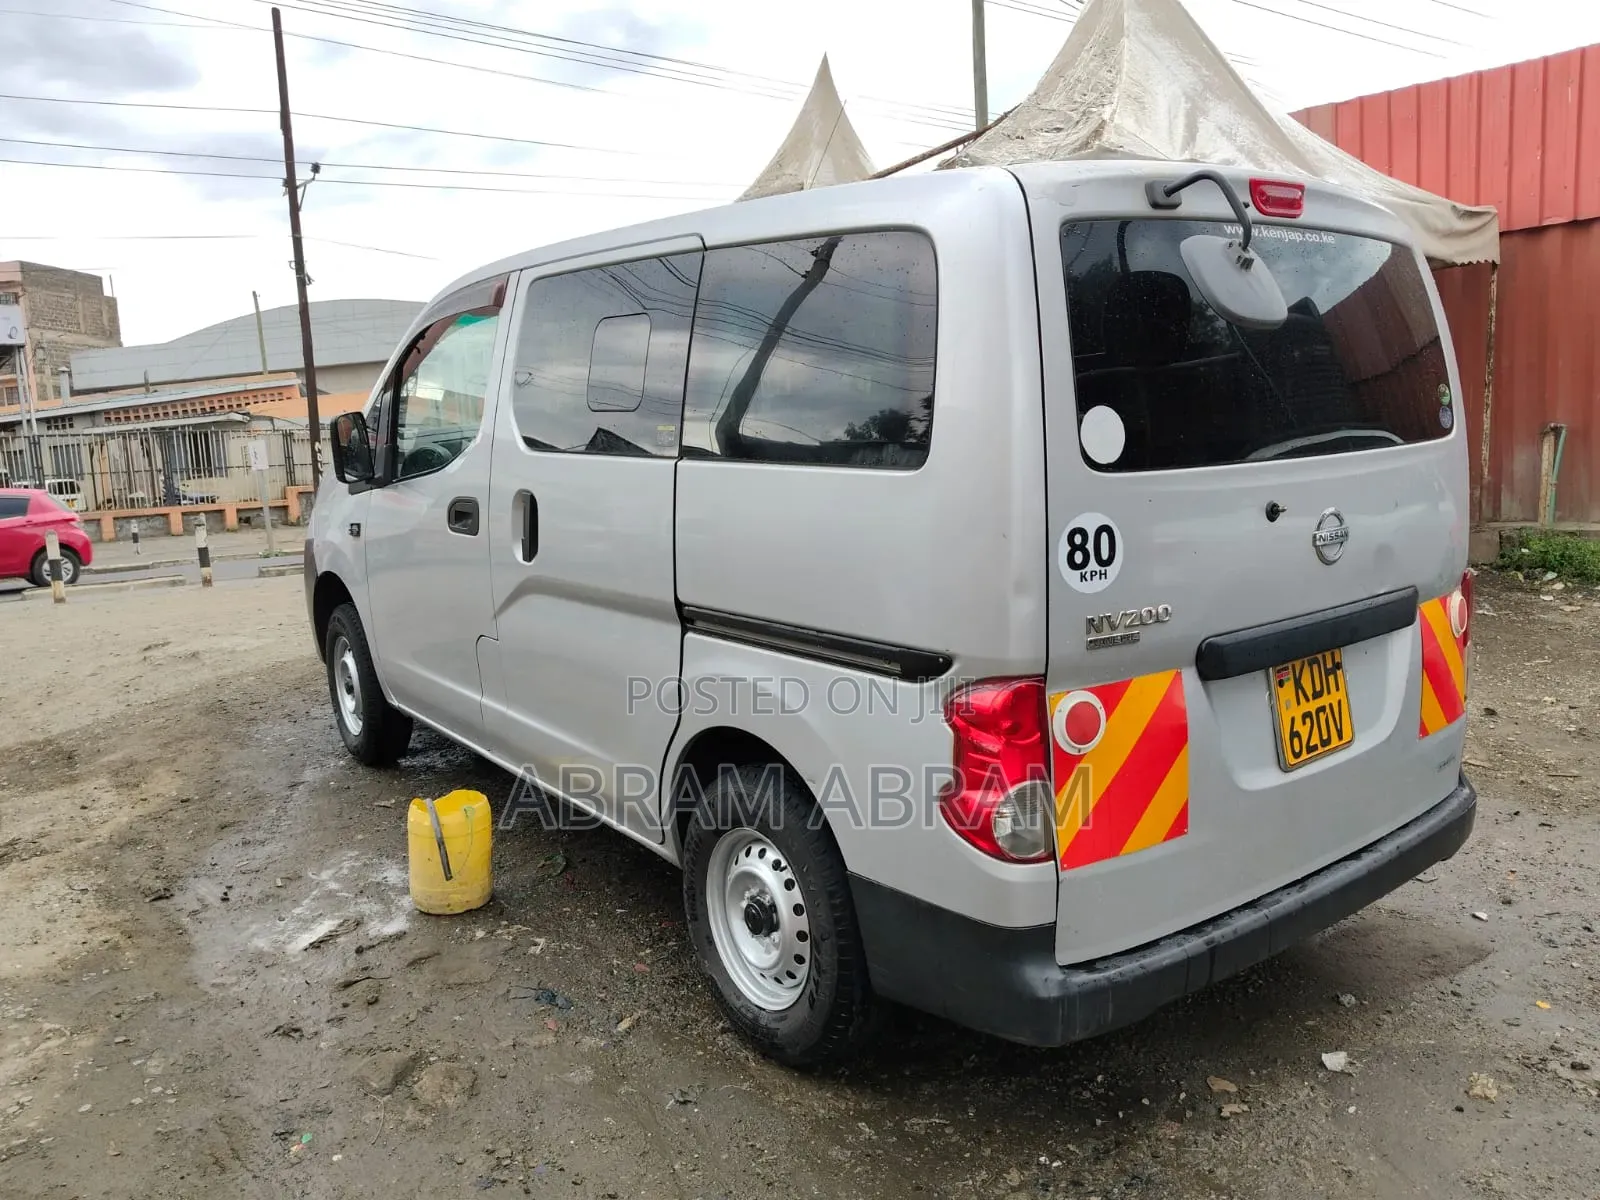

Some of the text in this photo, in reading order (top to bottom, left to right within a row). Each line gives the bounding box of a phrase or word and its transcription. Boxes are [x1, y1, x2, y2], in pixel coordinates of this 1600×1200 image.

[1066, 524, 1116, 571] 80
[1319, 530, 1348, 542] NISSAN
[1079, 569, 1108, 583] KPH
[1085, 604, 1172, 635] NV200
[1291, 651, 1340, 707] KDH
[1289, 699, 1343, 760] 620V
